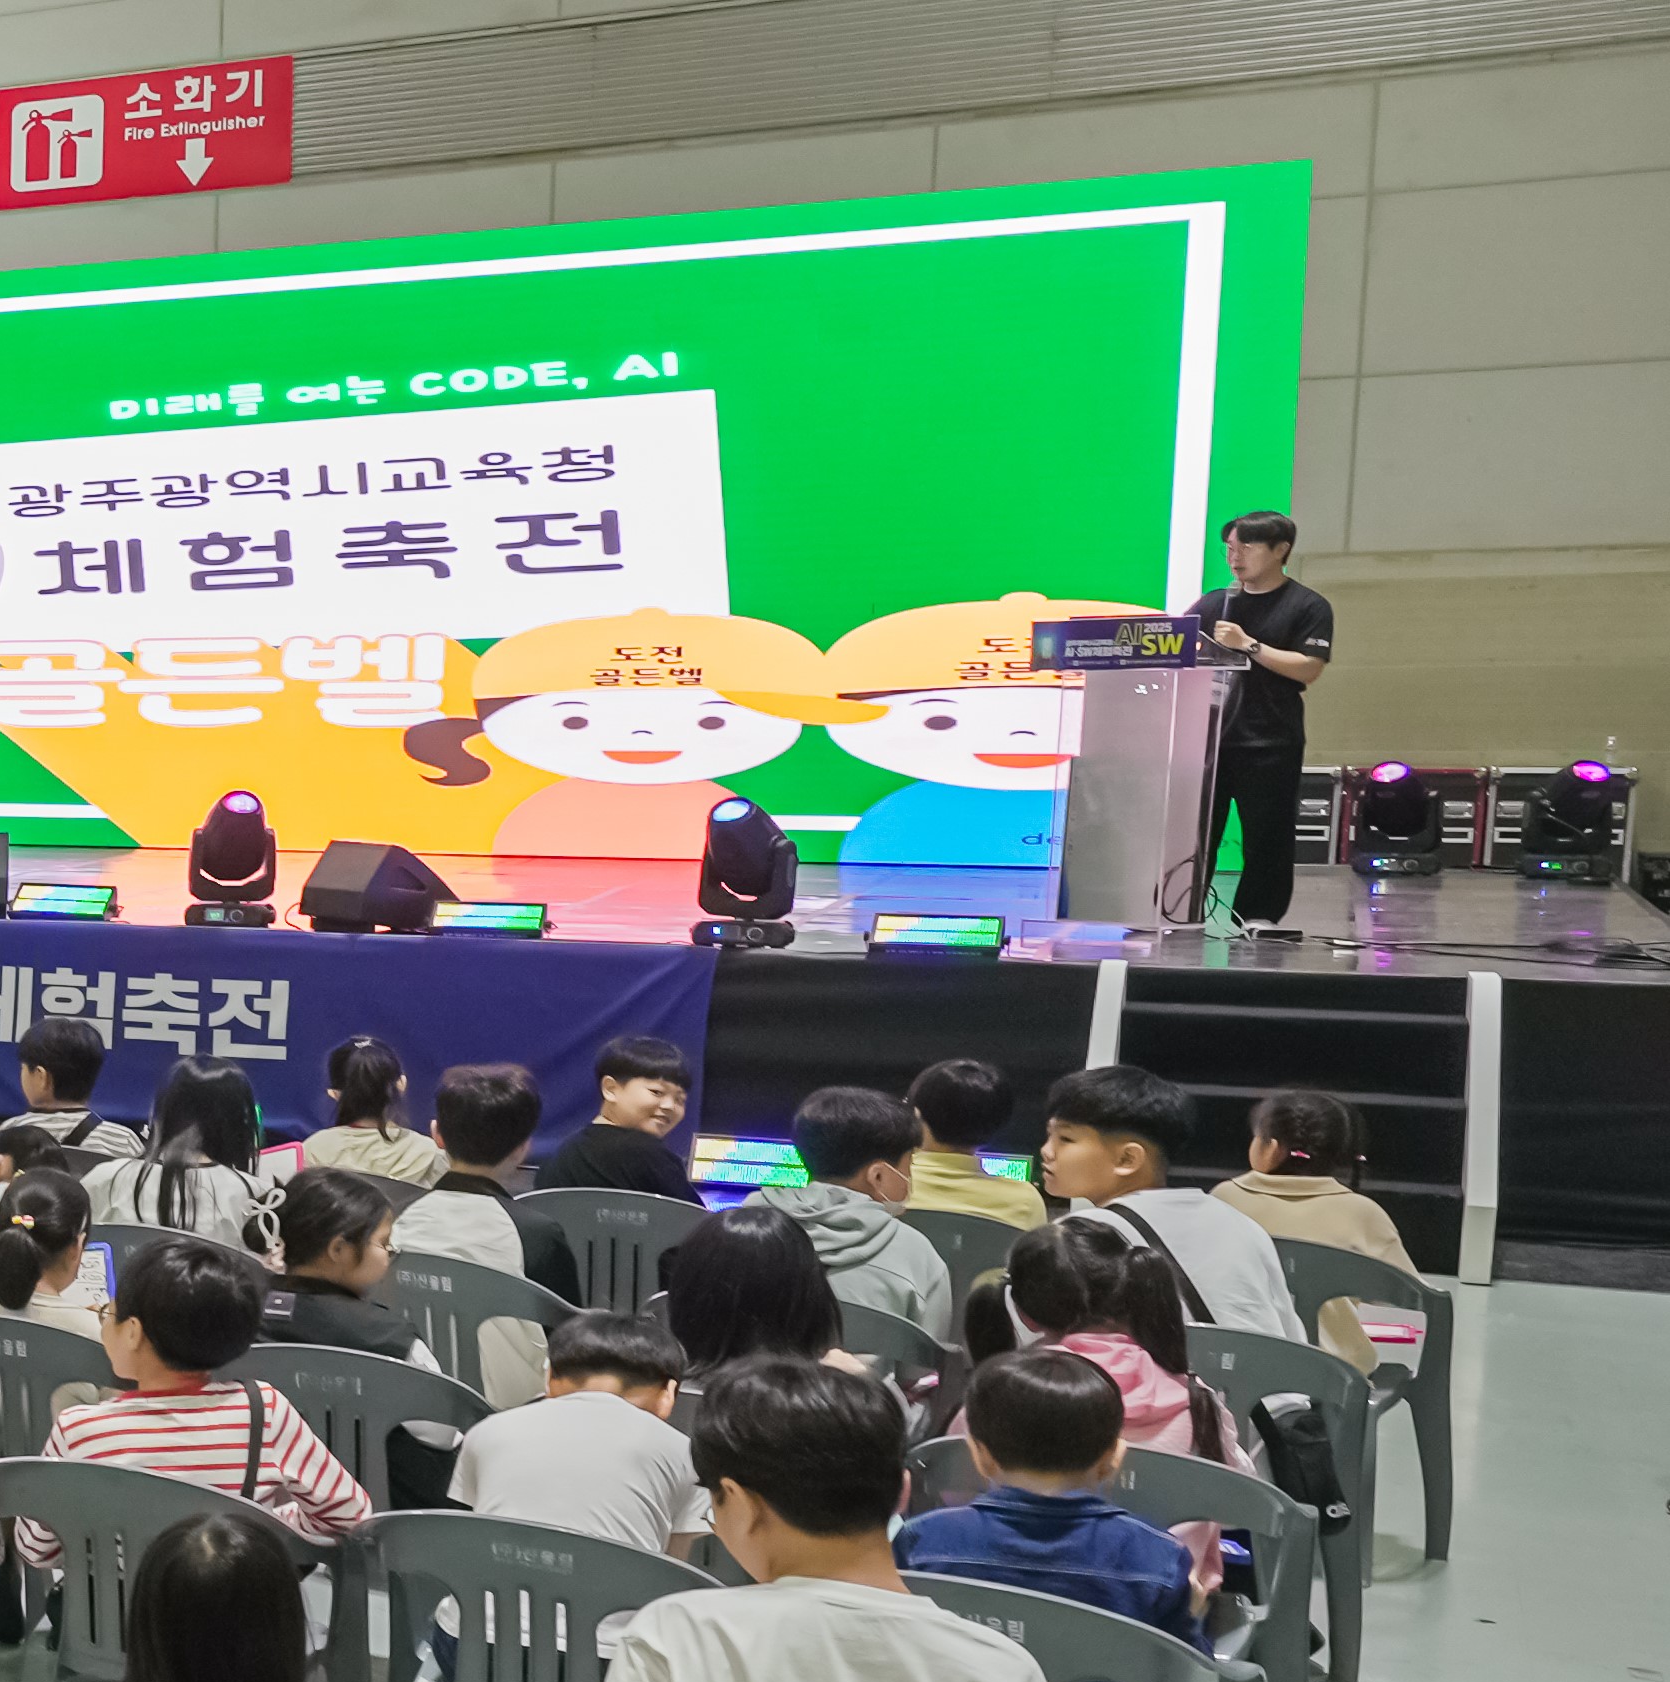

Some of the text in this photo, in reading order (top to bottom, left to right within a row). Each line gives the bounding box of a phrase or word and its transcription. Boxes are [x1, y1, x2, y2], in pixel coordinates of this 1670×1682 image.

[124, 69, 264, 121] 소화기
[124, 113, 266, 141] Fire Extinguisher
[110, 352, 681, 420] 미래를 여는 CODE, AI
[7, 444, 617, 519] 광주광역시교육청
[1114, 623, 1142, 645] AI
[1144, 622, 1173, 633] 2025
[1141, 633, 1185, 656] SW
[609, 645, 684, 664] 도전
[589, 667, 704, 687] 골든벨
